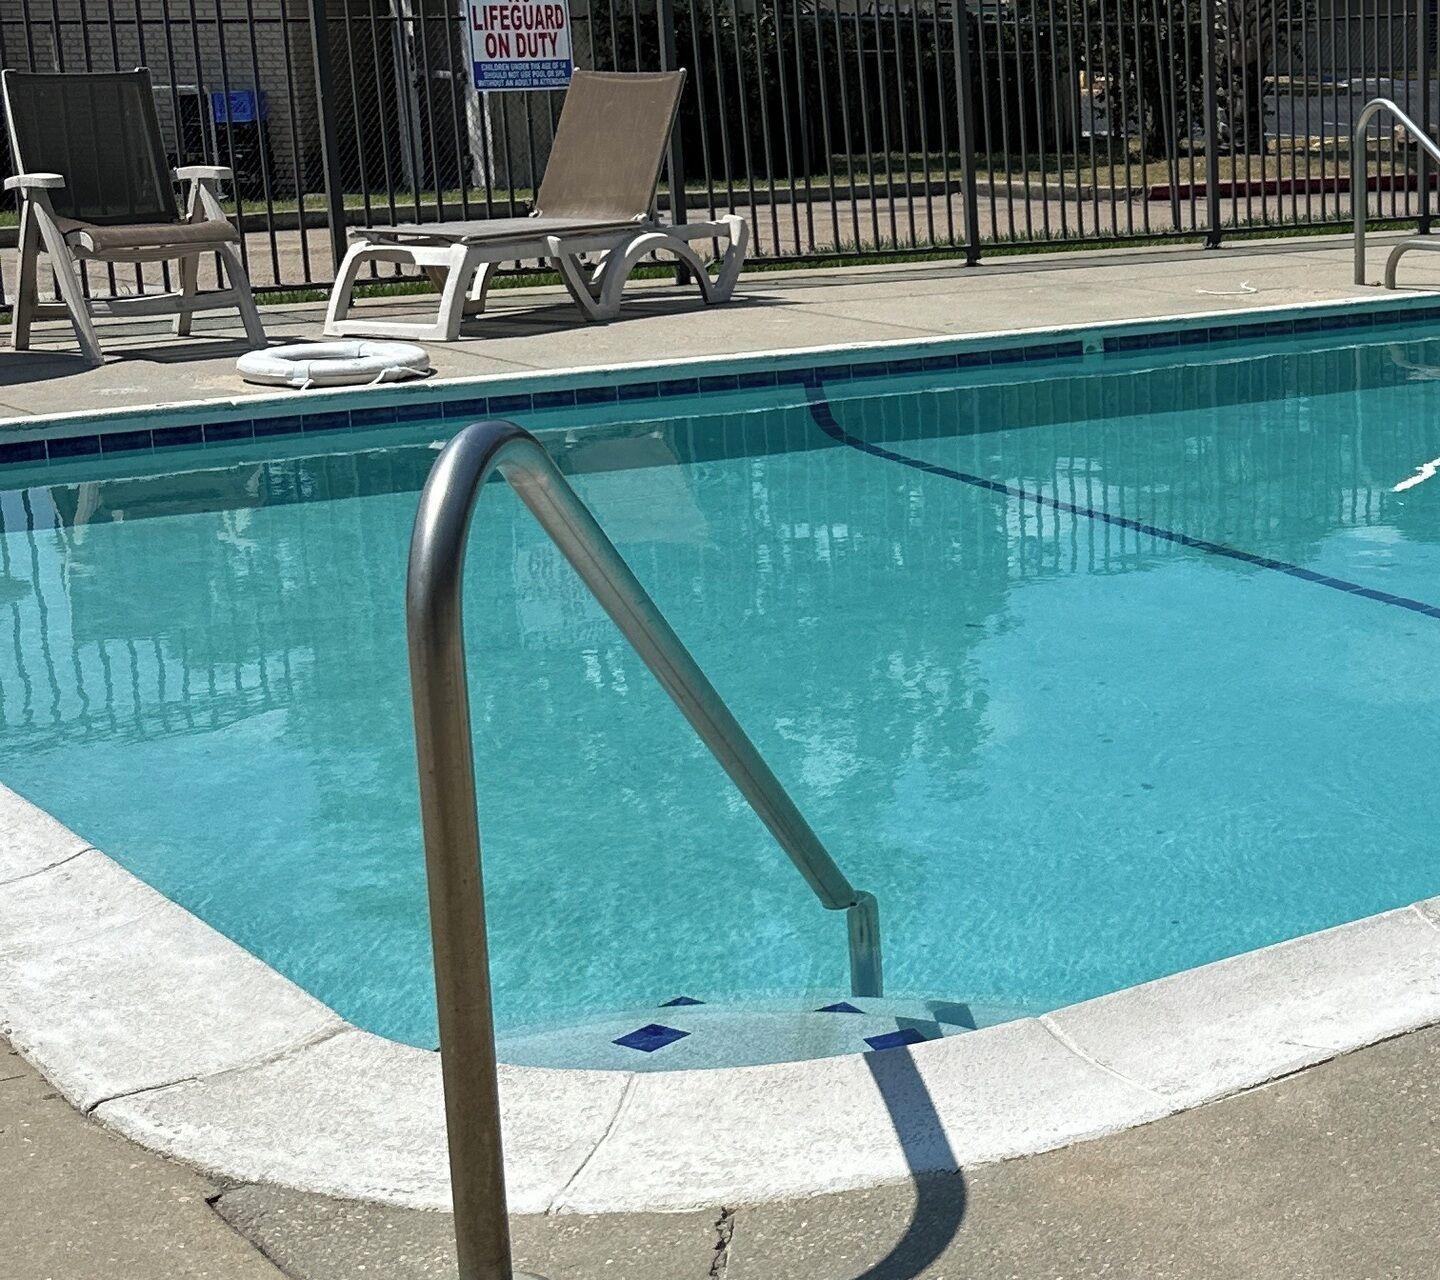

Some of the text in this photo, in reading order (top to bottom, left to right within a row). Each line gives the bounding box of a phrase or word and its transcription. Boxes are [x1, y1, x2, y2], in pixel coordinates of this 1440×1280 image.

[472, 4, 565, 31] LIFEGUARD
[485, 32, 558, 58] ON DUTY
[481, 63, 510, 71] CHILDREN
[531, 62, 541, 70] THE
[541, 62, 551, 70] AGE
[552, 61, 559, 69] OF
[532, 70, 546, 78] POOL
[532, 78, 539, 86] IN
